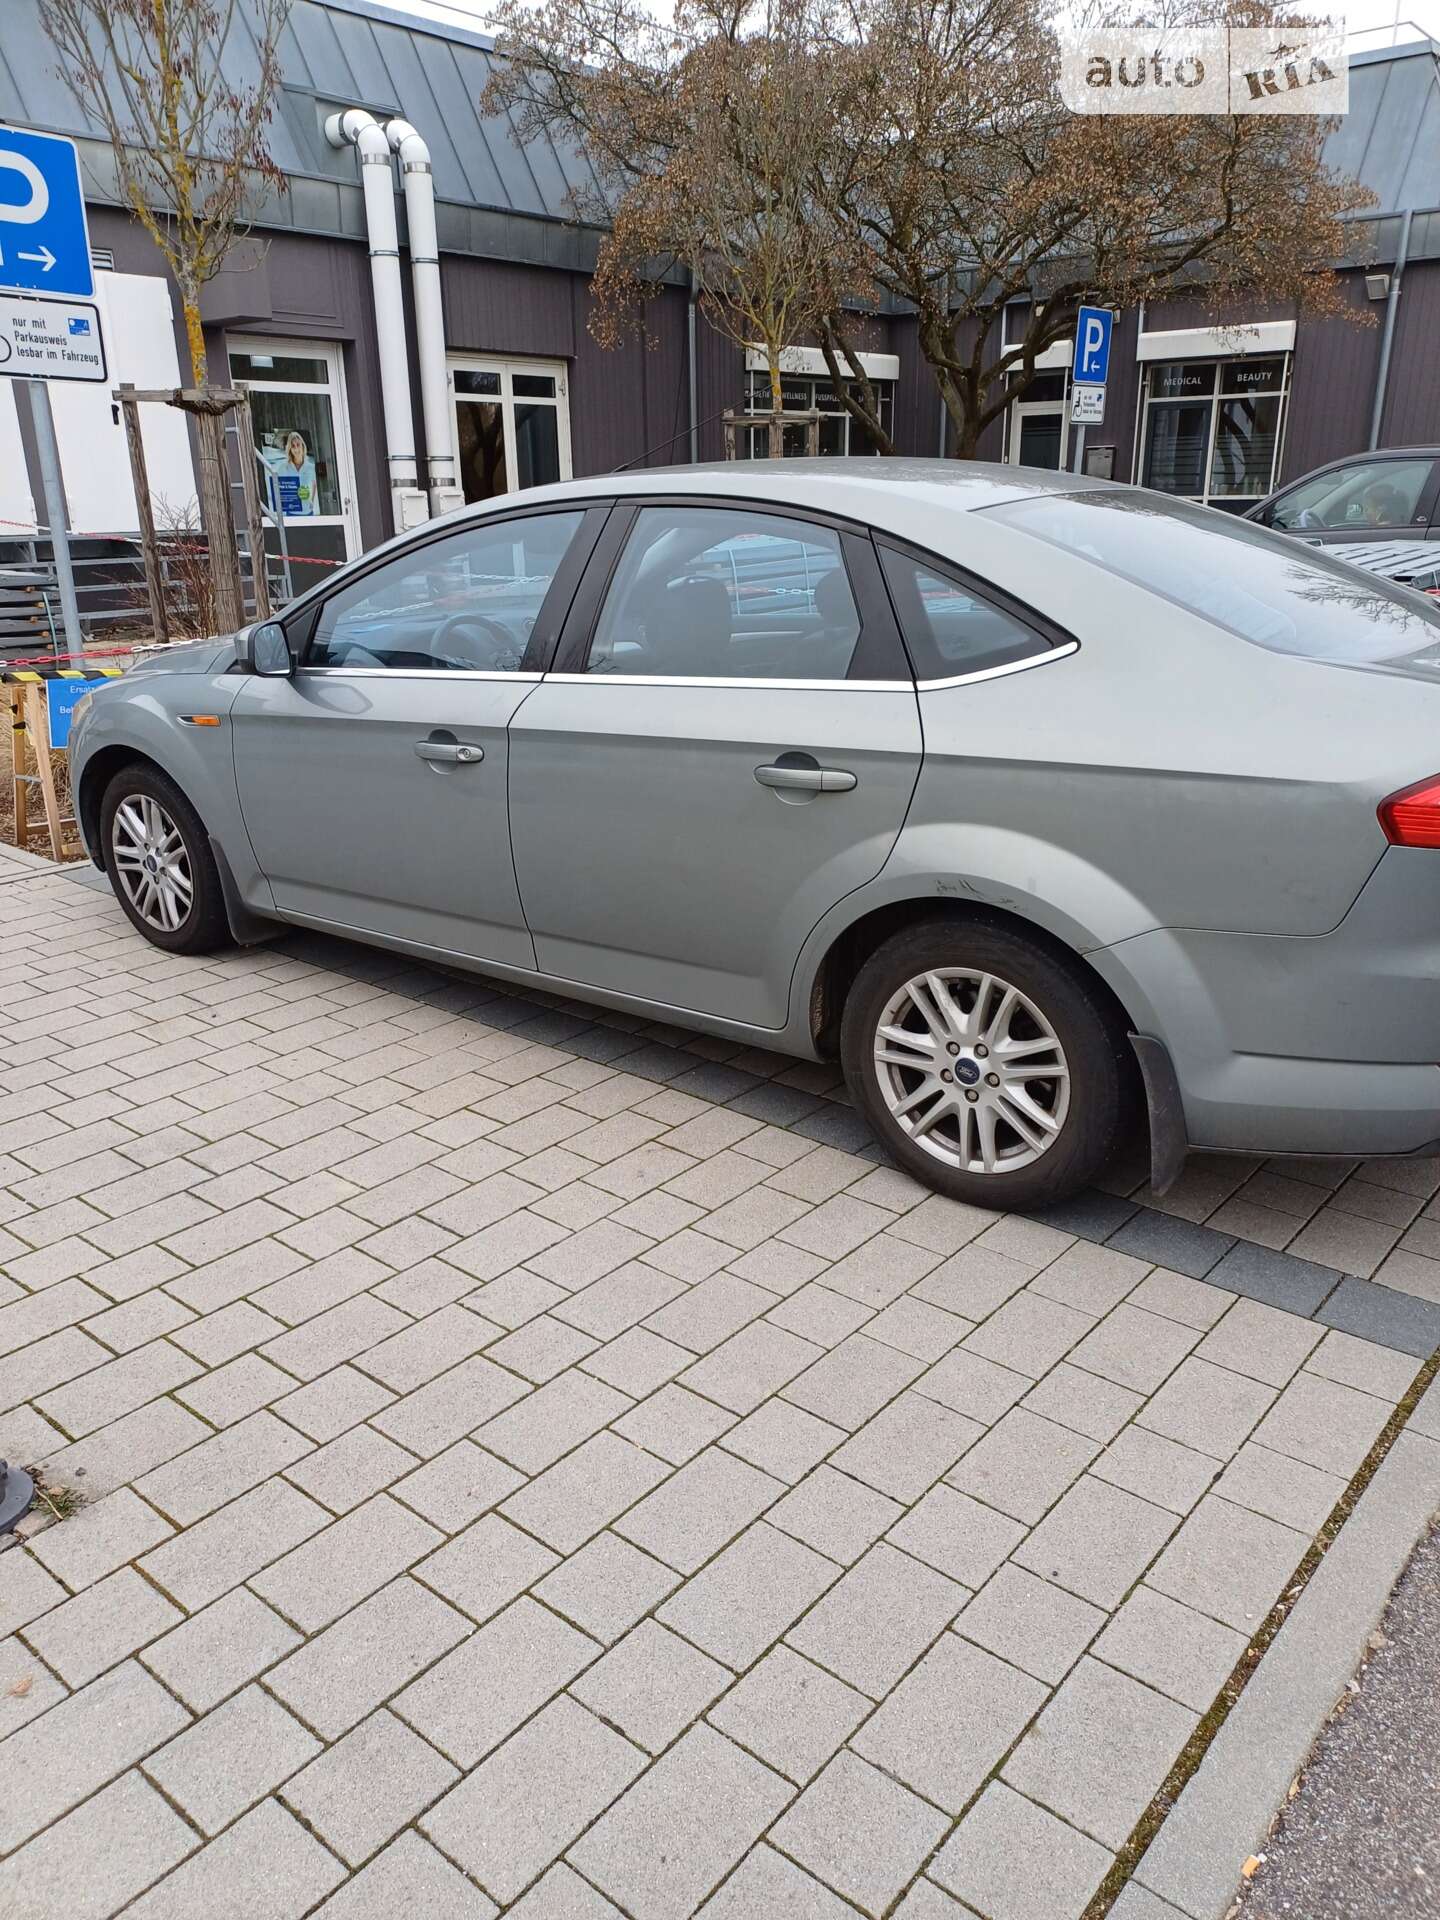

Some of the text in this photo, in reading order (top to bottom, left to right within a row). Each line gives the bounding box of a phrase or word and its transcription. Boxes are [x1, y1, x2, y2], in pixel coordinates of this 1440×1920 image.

[12, 317, 47, 329] nur mit
[14, 330, 68, 346] Parkausweis
[1083, 317, 1104, 373] P
[16, 345, 99, 366] lesbar im Fahrzeug
[1163, 371, 1273, 387] MEDICAL BEAUTY
